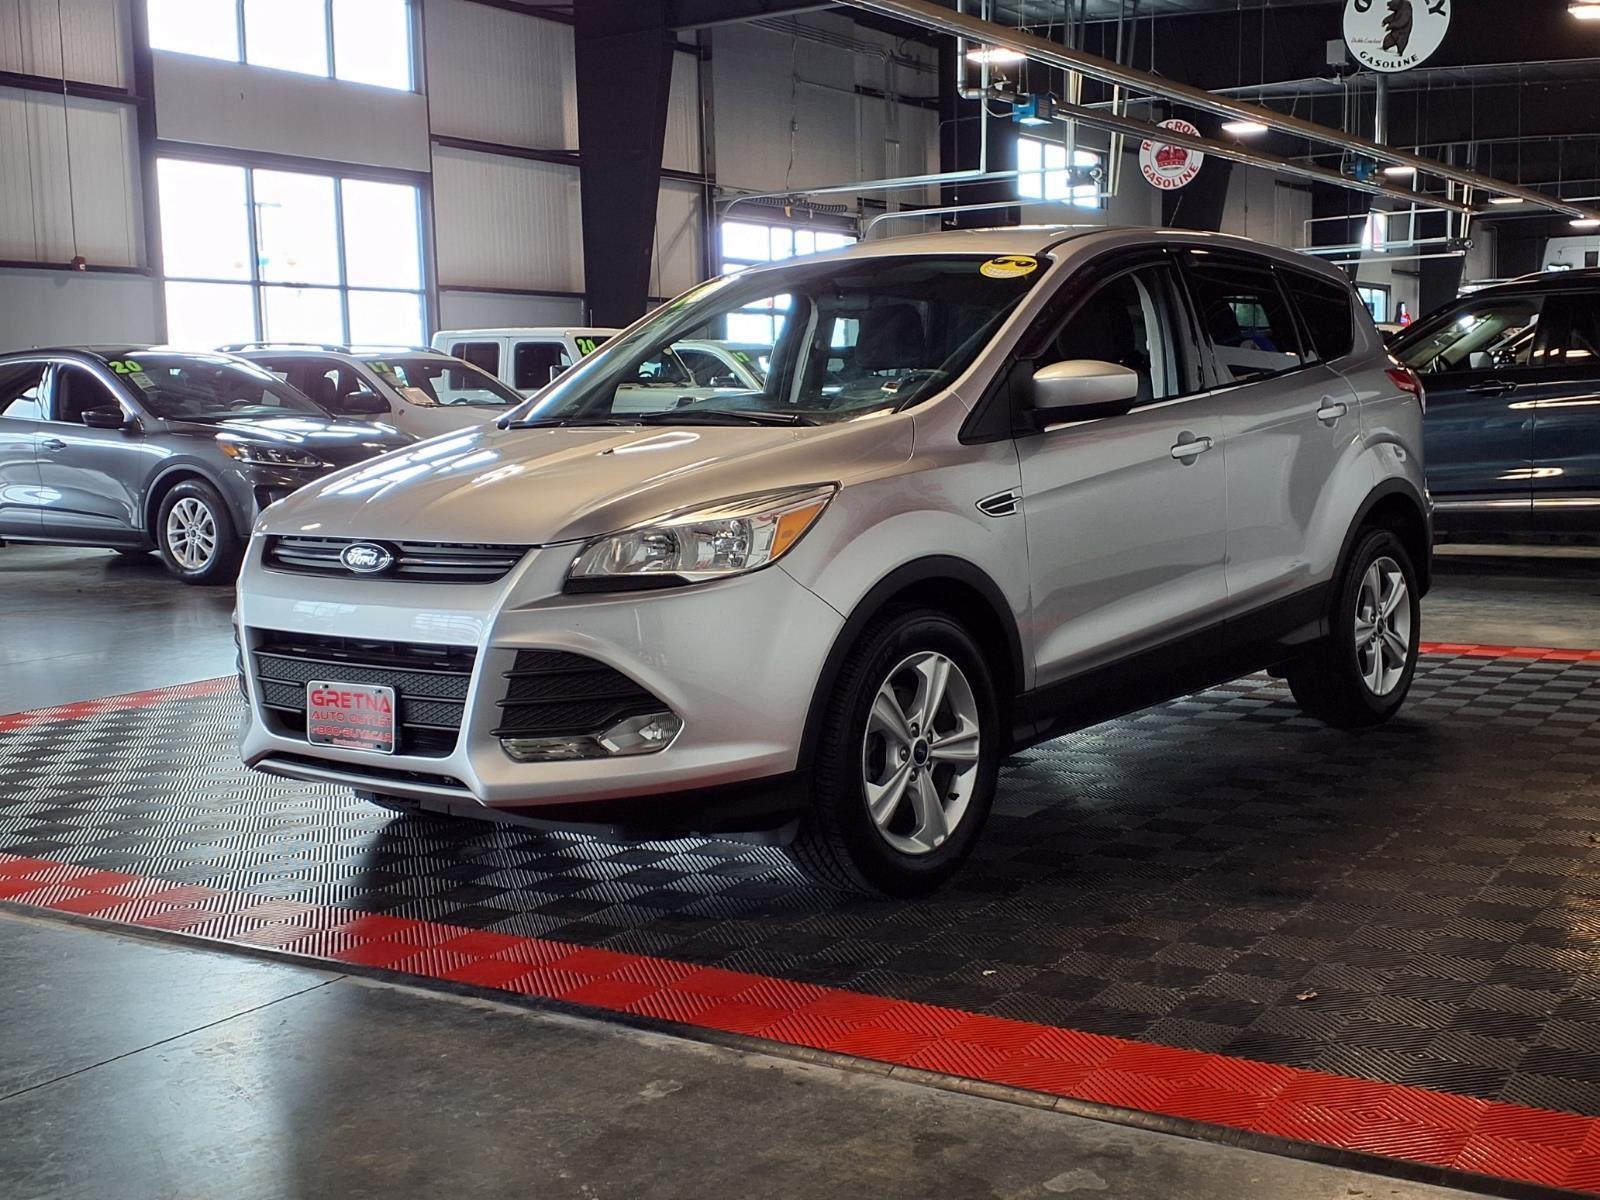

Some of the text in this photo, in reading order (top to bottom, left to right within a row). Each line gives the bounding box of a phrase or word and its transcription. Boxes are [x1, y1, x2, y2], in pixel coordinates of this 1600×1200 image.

[1359, 50, 1420, 69] GASOLINE
[1166, 121, 1197, 137] CRO
[1142, 163, 1199, 188] GASOLINE
[108, 360, 143, 374] 20
[346, 546, 379, 566] Ford
[311, 690, 391, 713] GRETNA
[312, 711, 344, 722] AUTO
